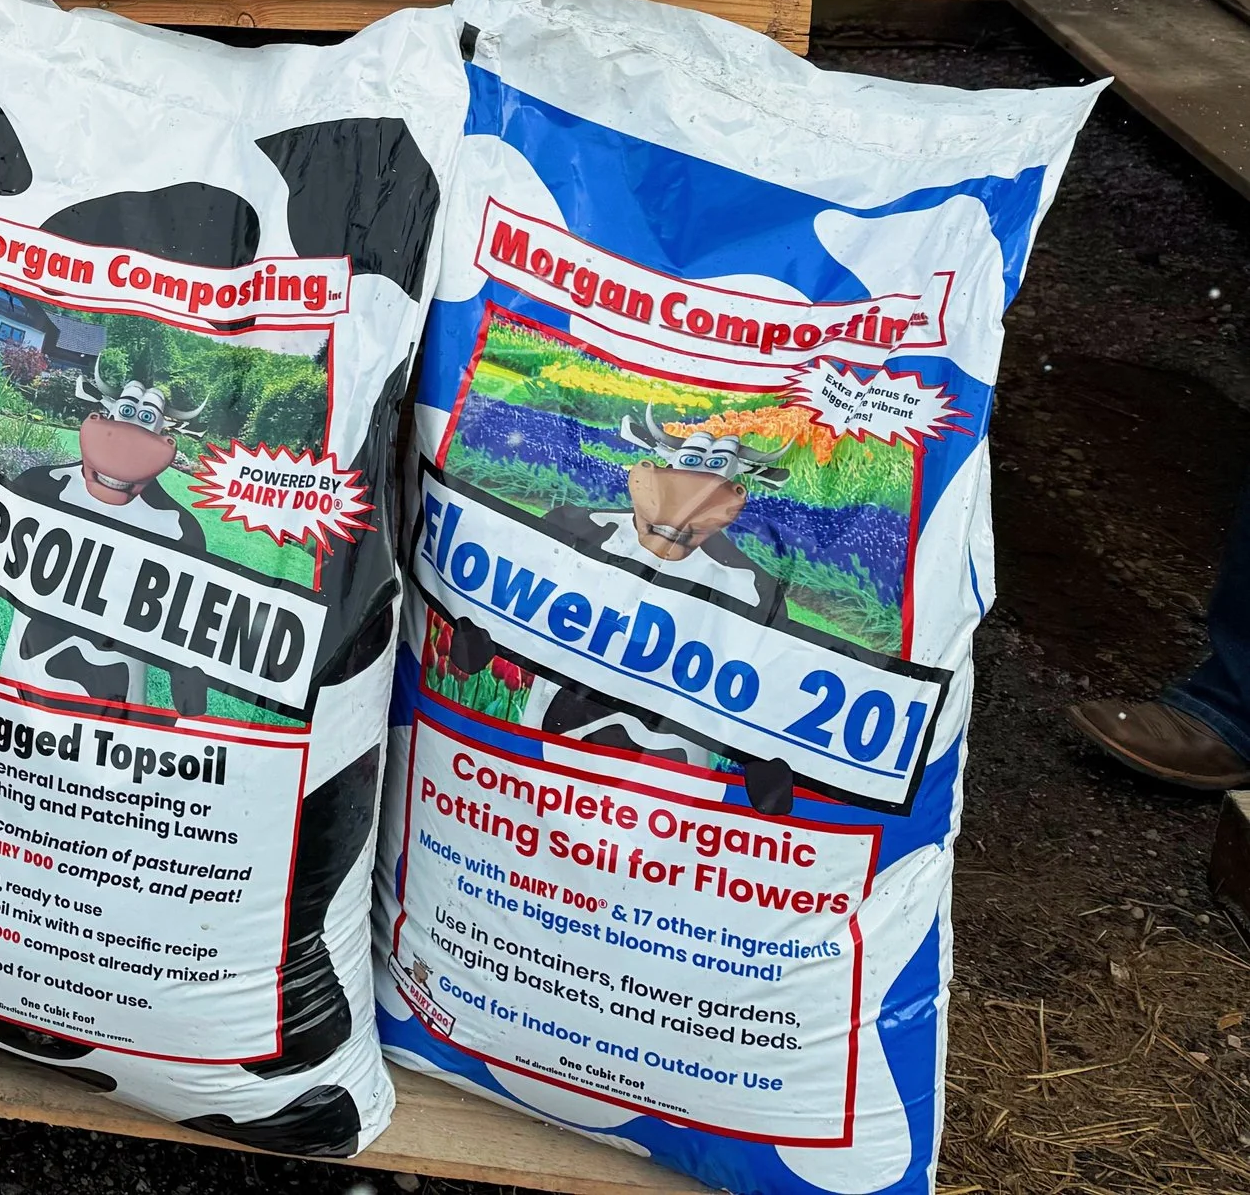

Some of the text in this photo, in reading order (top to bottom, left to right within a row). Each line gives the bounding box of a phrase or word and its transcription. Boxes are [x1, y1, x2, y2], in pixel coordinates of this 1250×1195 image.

[107, 255, 327, 312] Composting
[490, 220, 652, 324] Morgan
[825, 373, 851, 397] Extra
[903, 392, 921, 406] for
[871, 399, 914, 420] vibrant
[227, 480, 288, 508] DAIRY
[239, 466, 341, 493] POWERED BY
[123, 560, 306, 683] BLEND
[423, 491, 928, 771] FlowerDoo 201
[93, 728, 228, 785] Topsoil
[57, 777, 186, 818] Landscaping
[189, 803, 212, 817] or
[452, 752, 816, 868] Complete Organic
[39, 798, 77, 818] and
[80, 805, 170, 839] Patching
[174, 820, 238, 845] Lawns
[112, 849, 133, 864] of
[132, 854, 253, 881] pastureland
[421, 776, 850, 914] Potting Soil for Flowers
[5, 881, 52, 908] ready
[54, 894, 71, 909] to
[73, 901, 103, 917] use
[419, 828, 462, 865] Made
[465, 855, 506, 884] with
[509, 871, 559, 900] DAIRY
[611, 904, 628, 923] &
[633, 908, 653, 927] 17
[656, 917, 717, 943] other
[721, 927, 841, 959] ingredients
[457, 875, 782, 982] for the biggest blooms around!
[17, 965, 41, 983] for
[43, 976, 114, 1002] outdoor
[116, 994, 152, 1010] use.
[435, 905, 801, 1029] Use in containers, flower gardens,
[20, 996, 95, 1025] One Cubic Foot
[559, 1056, 645, 1090] One Cubic Foot
